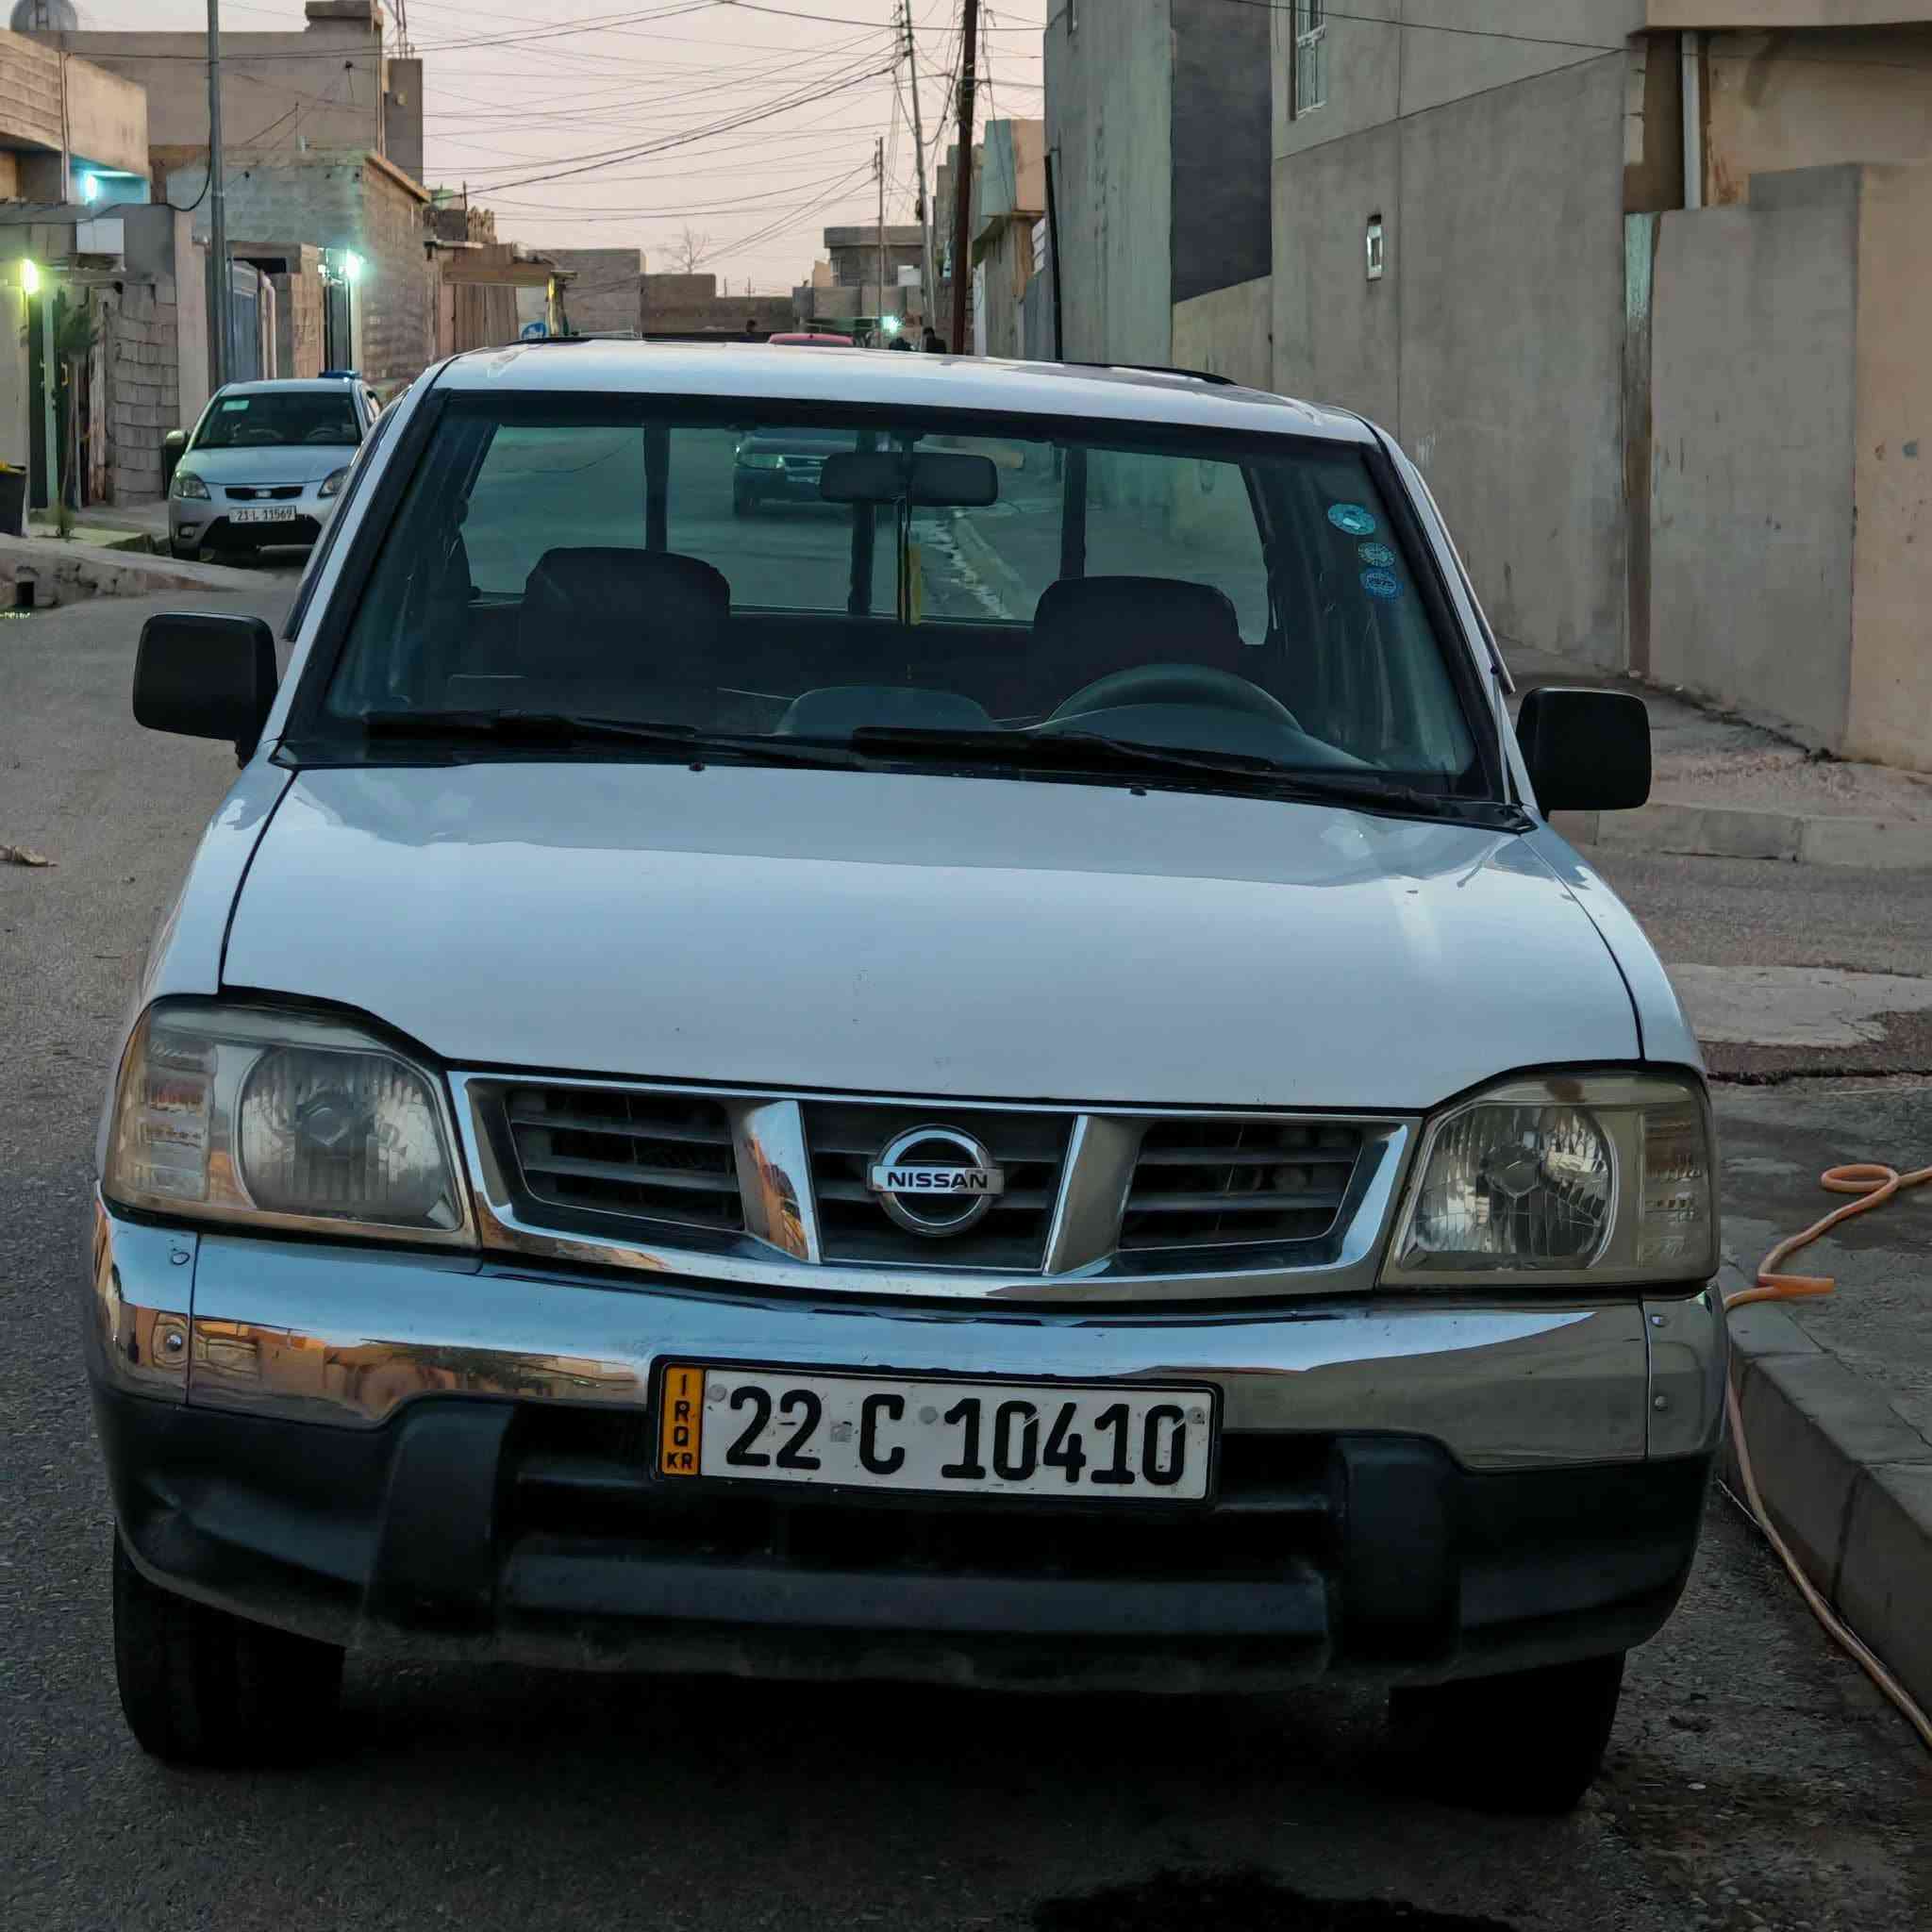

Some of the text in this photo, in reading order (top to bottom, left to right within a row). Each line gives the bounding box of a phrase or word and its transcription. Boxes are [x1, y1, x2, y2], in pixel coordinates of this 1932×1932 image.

[887, 1172, 989, 1190] NISSAN
[725, 1386, 1187, 1486] 22 C 10410
[666, 1452, 693, 1471] KR
